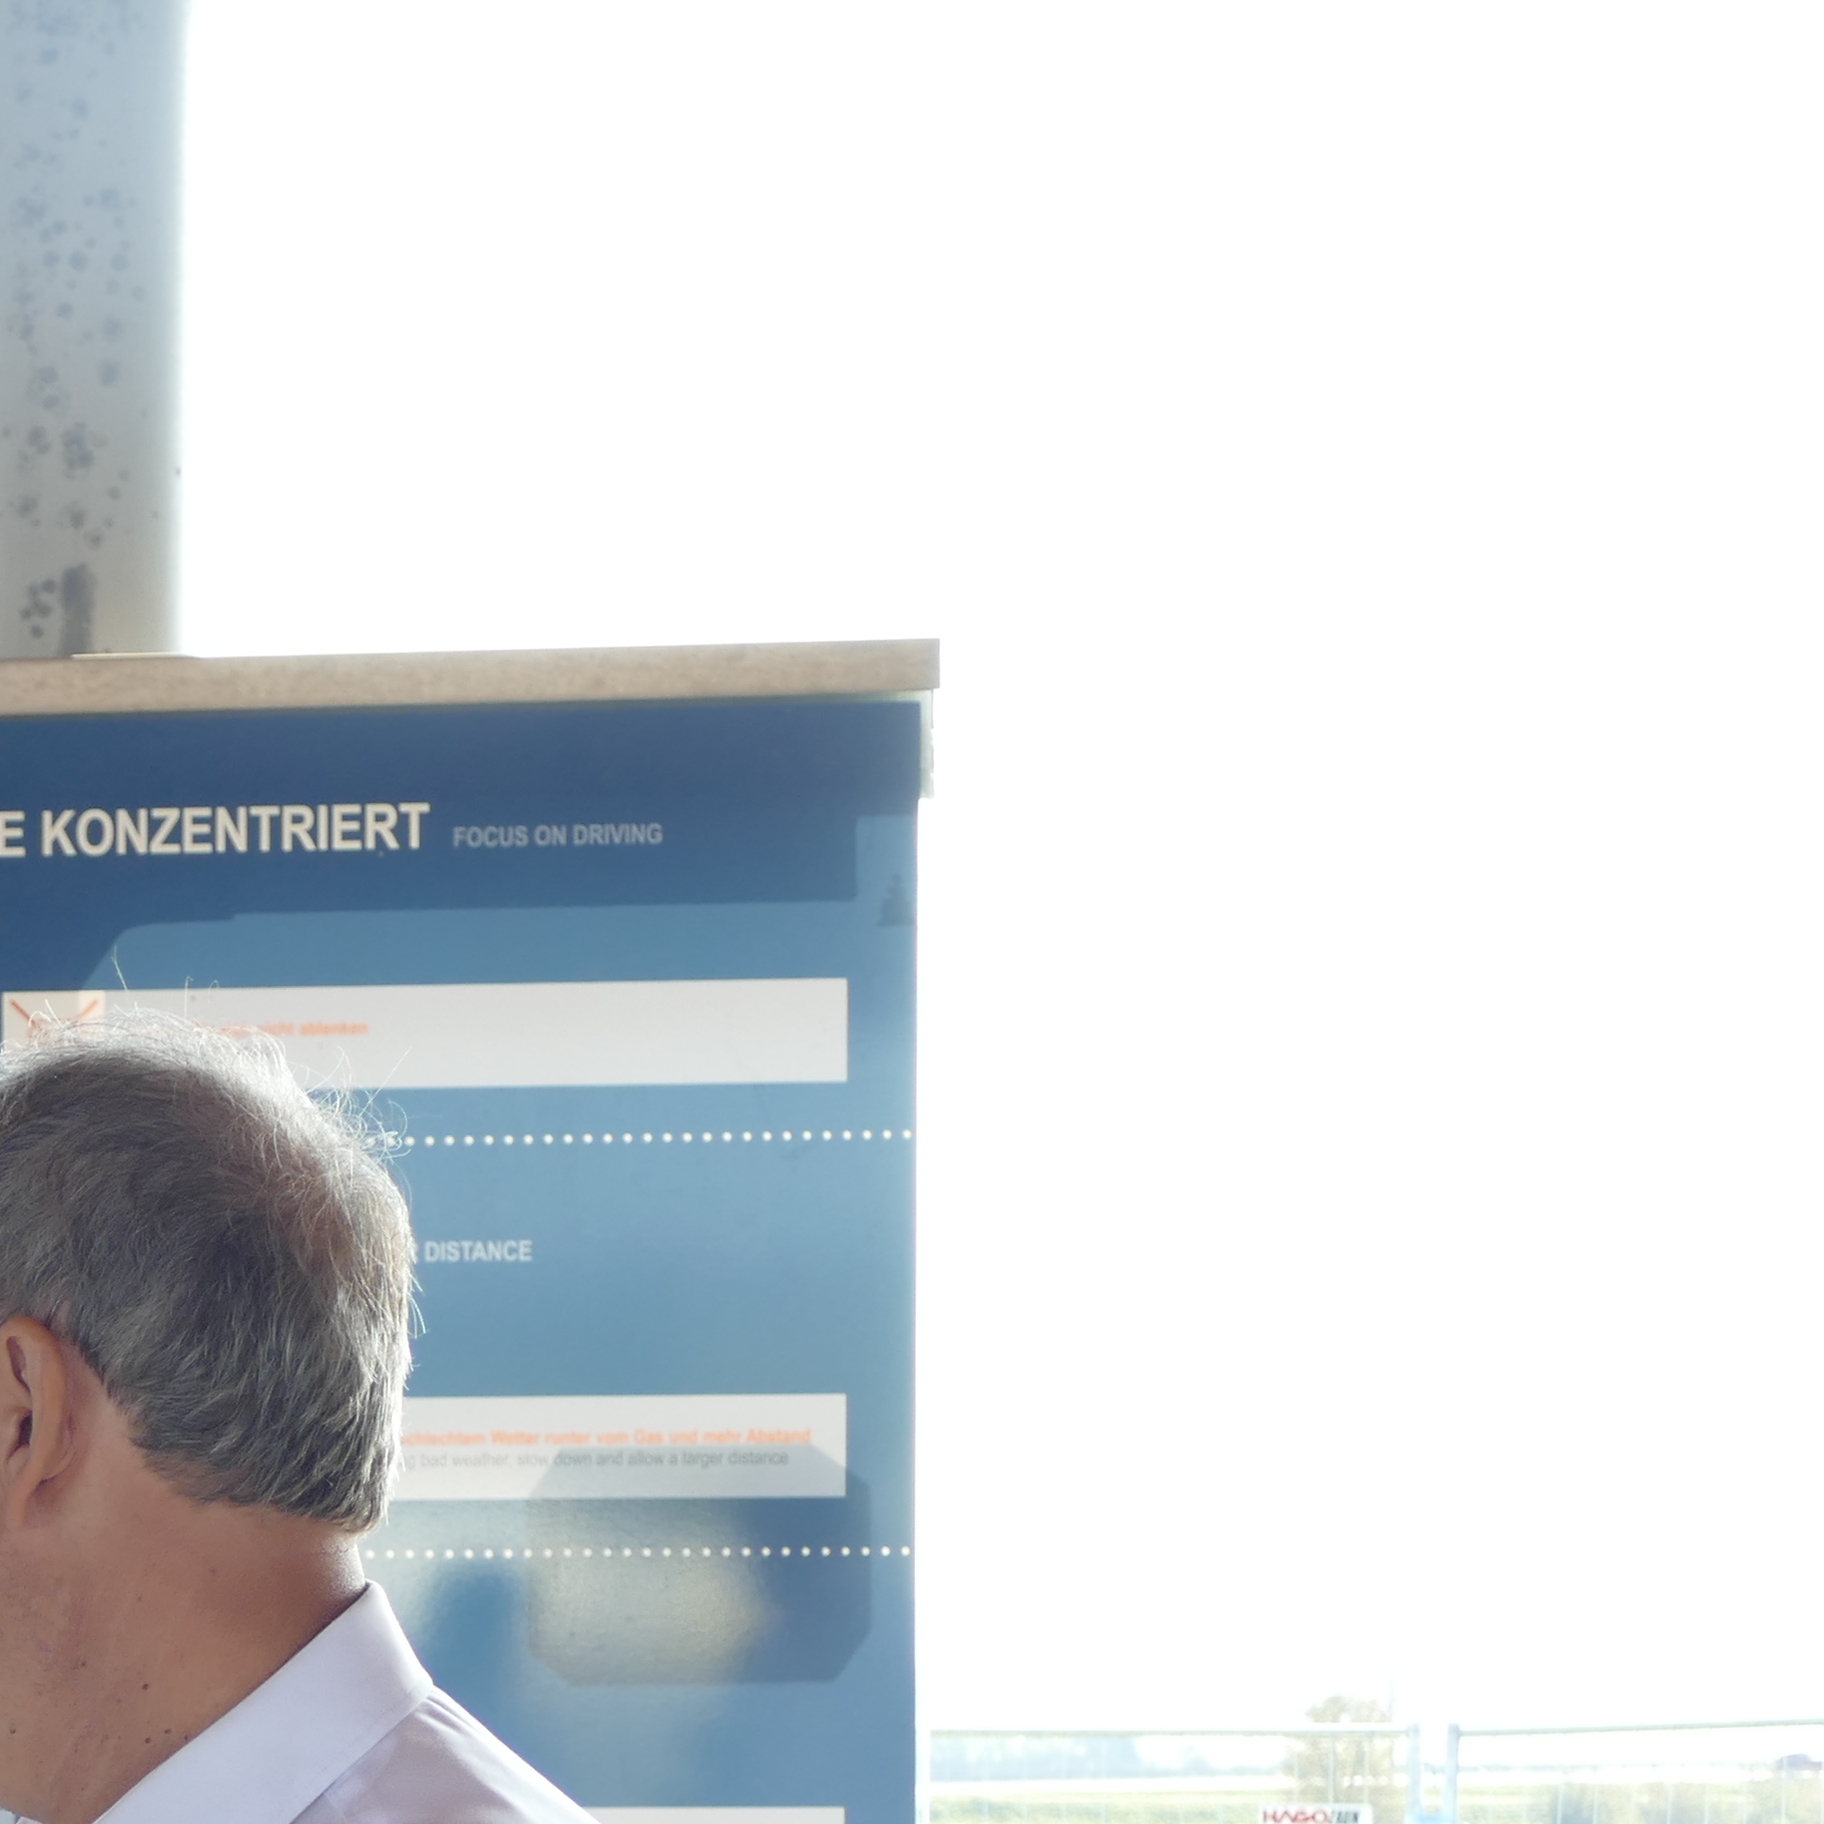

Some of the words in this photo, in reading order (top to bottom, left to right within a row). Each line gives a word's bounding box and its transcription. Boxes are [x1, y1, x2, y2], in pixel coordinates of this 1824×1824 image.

[40, 802, 431, 857] KONZENTRIERT
[453, 825, 529, 848] FOCUS
[533, 823, 567, 847] ON
[572, 821, 664, 847] DRIVING
[424, 1239, 533, 1263] DISTANCE
